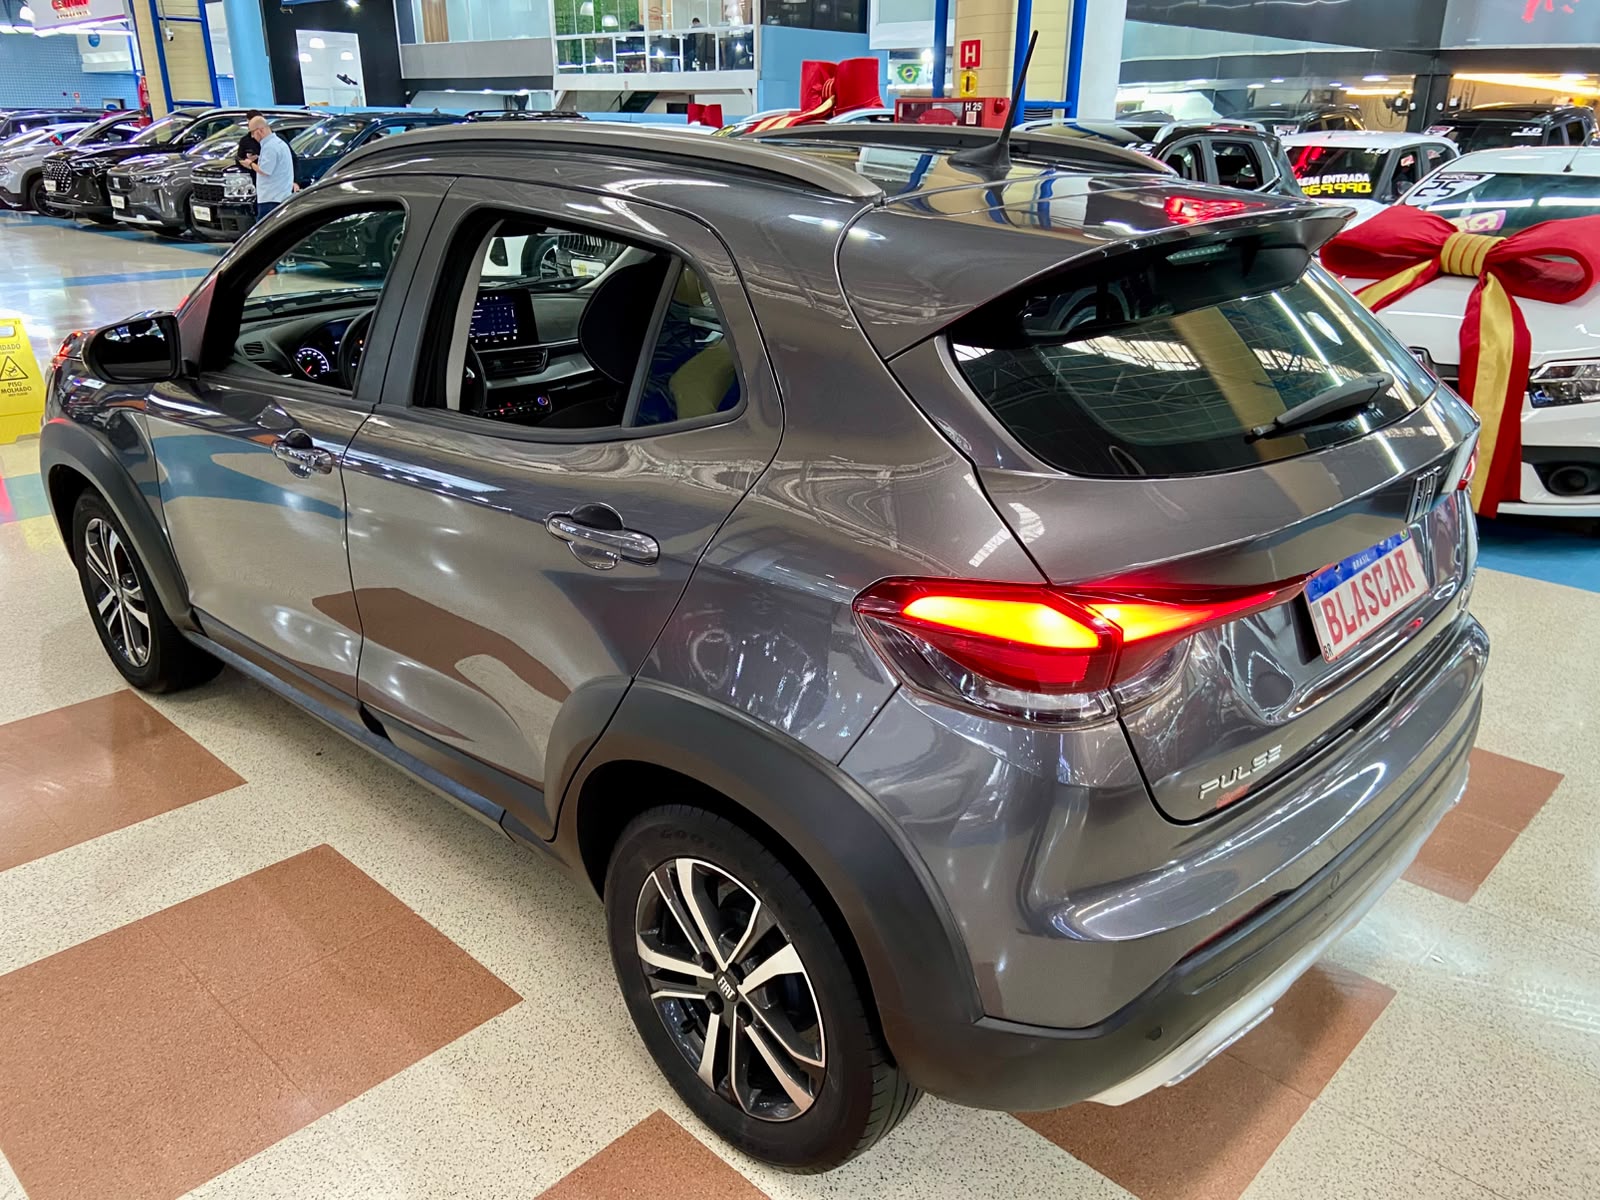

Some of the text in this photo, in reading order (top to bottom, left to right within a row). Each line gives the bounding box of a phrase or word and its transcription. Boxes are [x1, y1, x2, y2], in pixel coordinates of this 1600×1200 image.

[965, 44, 976, 63] H
[965, 103, 972, 111] H
[1322, 174, 1369, 183] ENTRADA
[1413, 180, 1463, 197] 25
[1, 386, 32, 394] MOLHADO
[1321, 549, 1415, 645] BLASCAR
[1199, 745, 1282, 800] PULSE
[718, 976, 735, 999] FIAT
